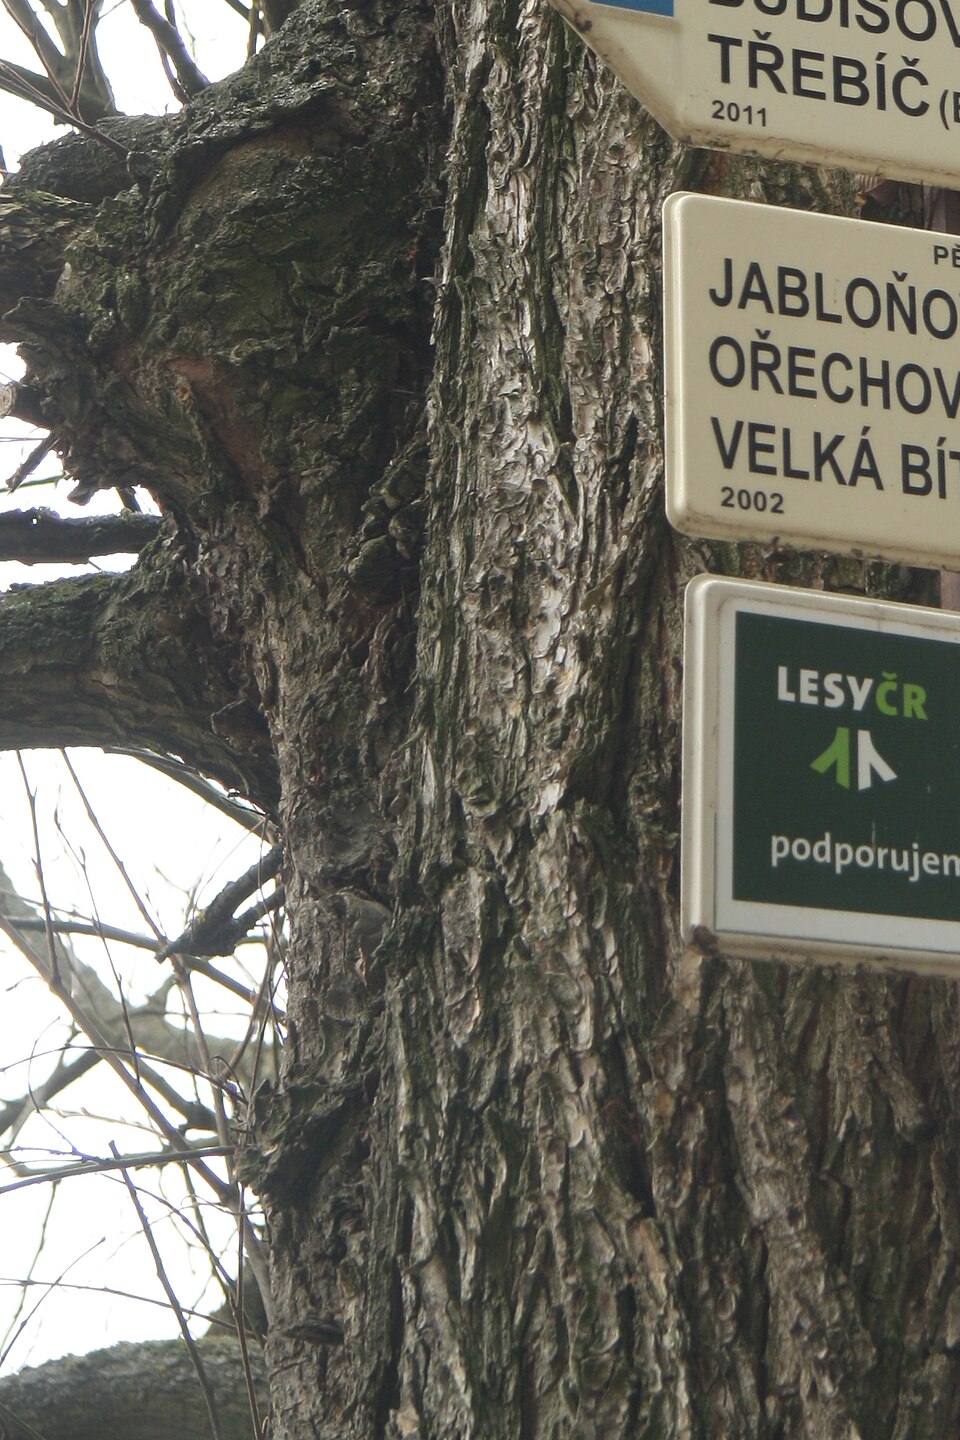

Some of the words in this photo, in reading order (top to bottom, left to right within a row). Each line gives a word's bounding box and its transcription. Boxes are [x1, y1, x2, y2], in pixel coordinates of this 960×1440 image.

[707, 29, 930, 117] TŘEBÍČ
[711, 100, 767, 127] 2011
[710, 416, 885, 491] VELKÁ
[720, 486, 785, 514] 2002
